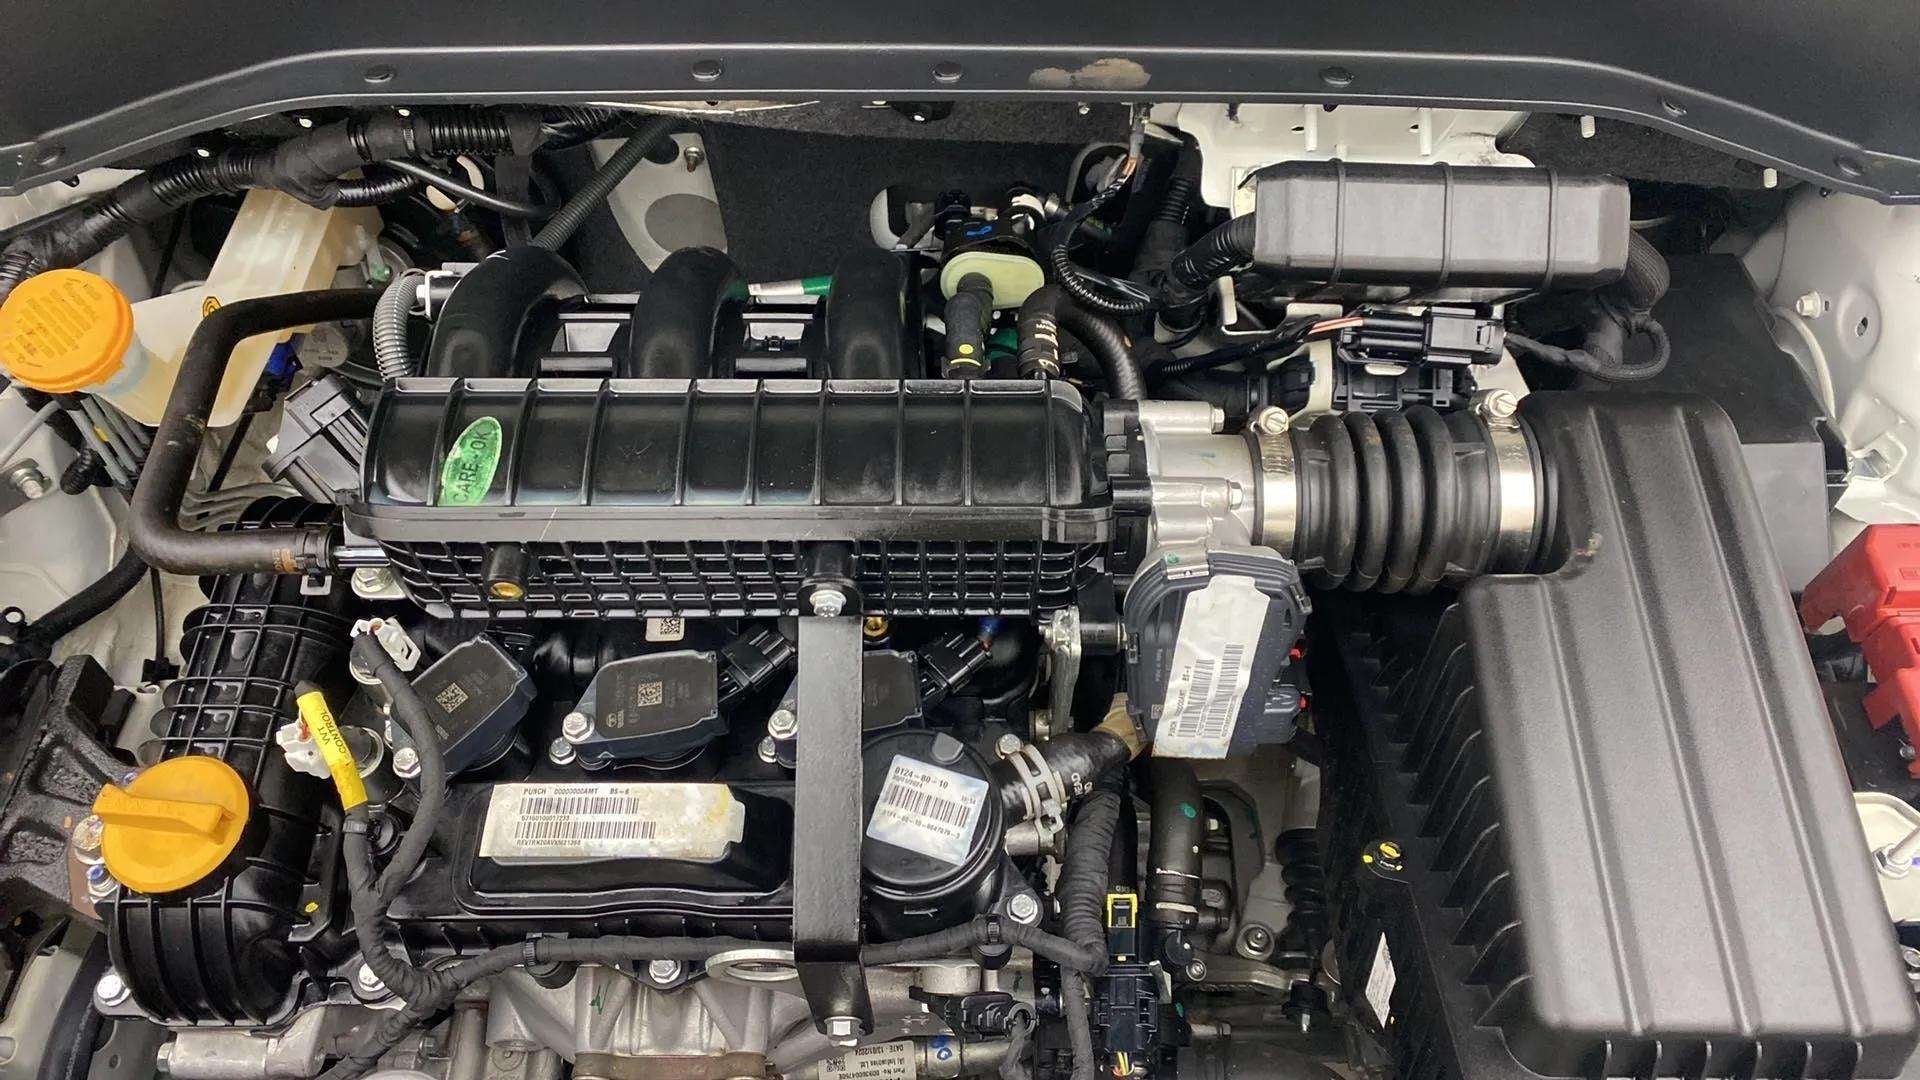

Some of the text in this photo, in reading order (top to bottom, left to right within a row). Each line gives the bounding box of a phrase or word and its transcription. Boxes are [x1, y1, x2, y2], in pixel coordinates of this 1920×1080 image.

[317, 726, 331, 745] VVT
[320, 711, 347, 754] CONTROL
[888, 1043, 904, 1053] DATE
